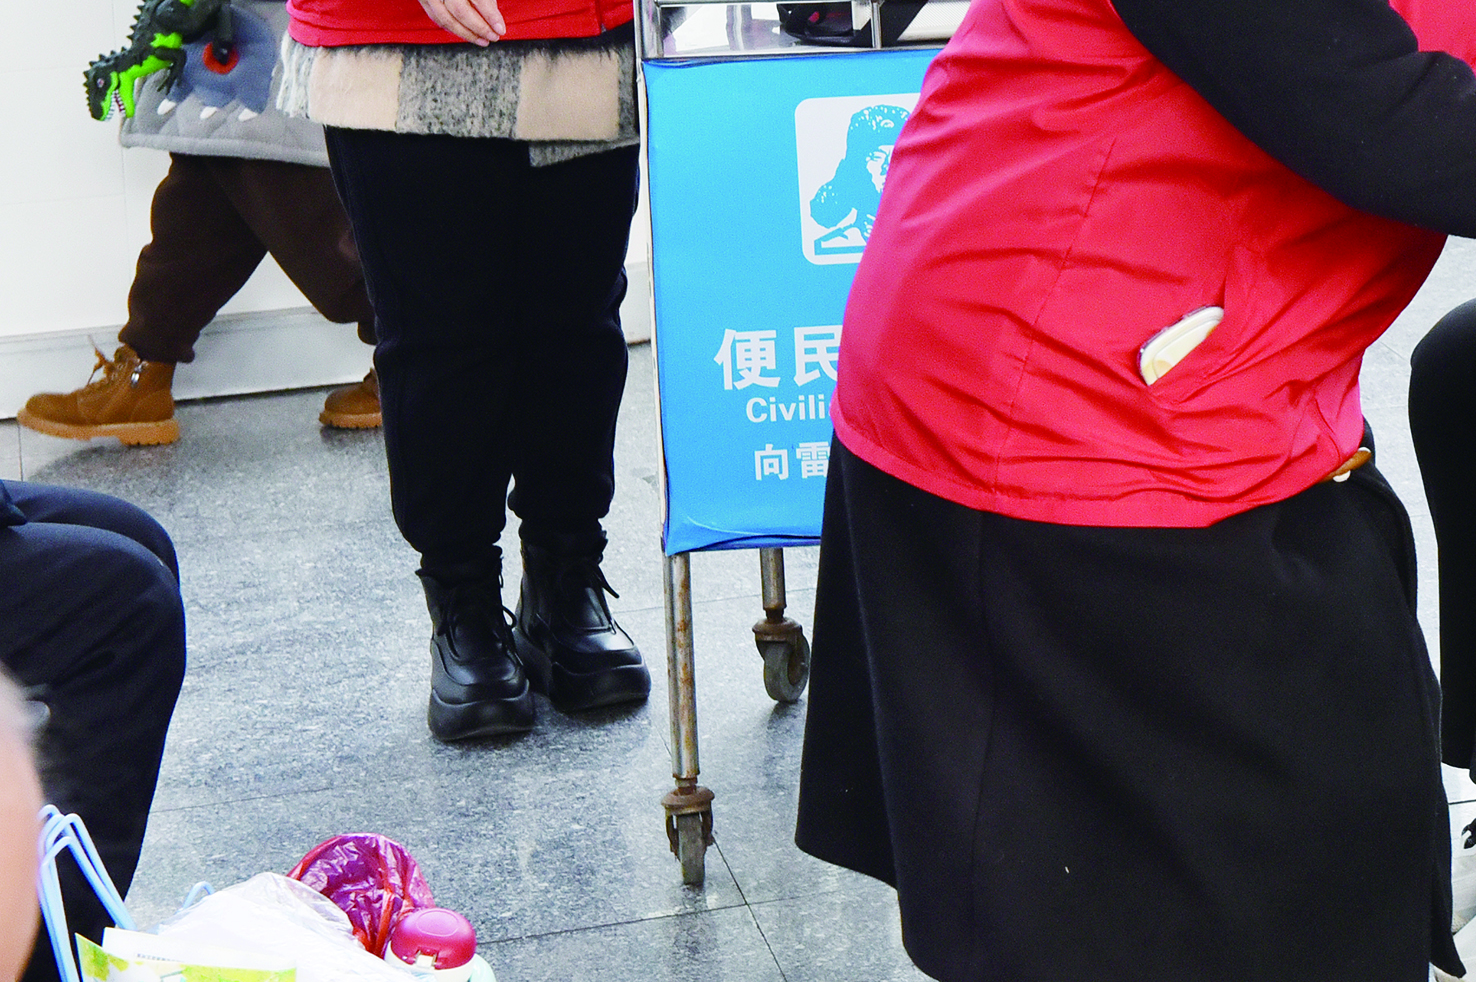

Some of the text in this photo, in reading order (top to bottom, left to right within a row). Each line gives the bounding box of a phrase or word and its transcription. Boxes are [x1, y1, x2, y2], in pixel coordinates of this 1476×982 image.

[713, 324, 843, 391] 便民
[746, 394, 830, 423] Civili
[755, 441, 831, 481] 向雷
